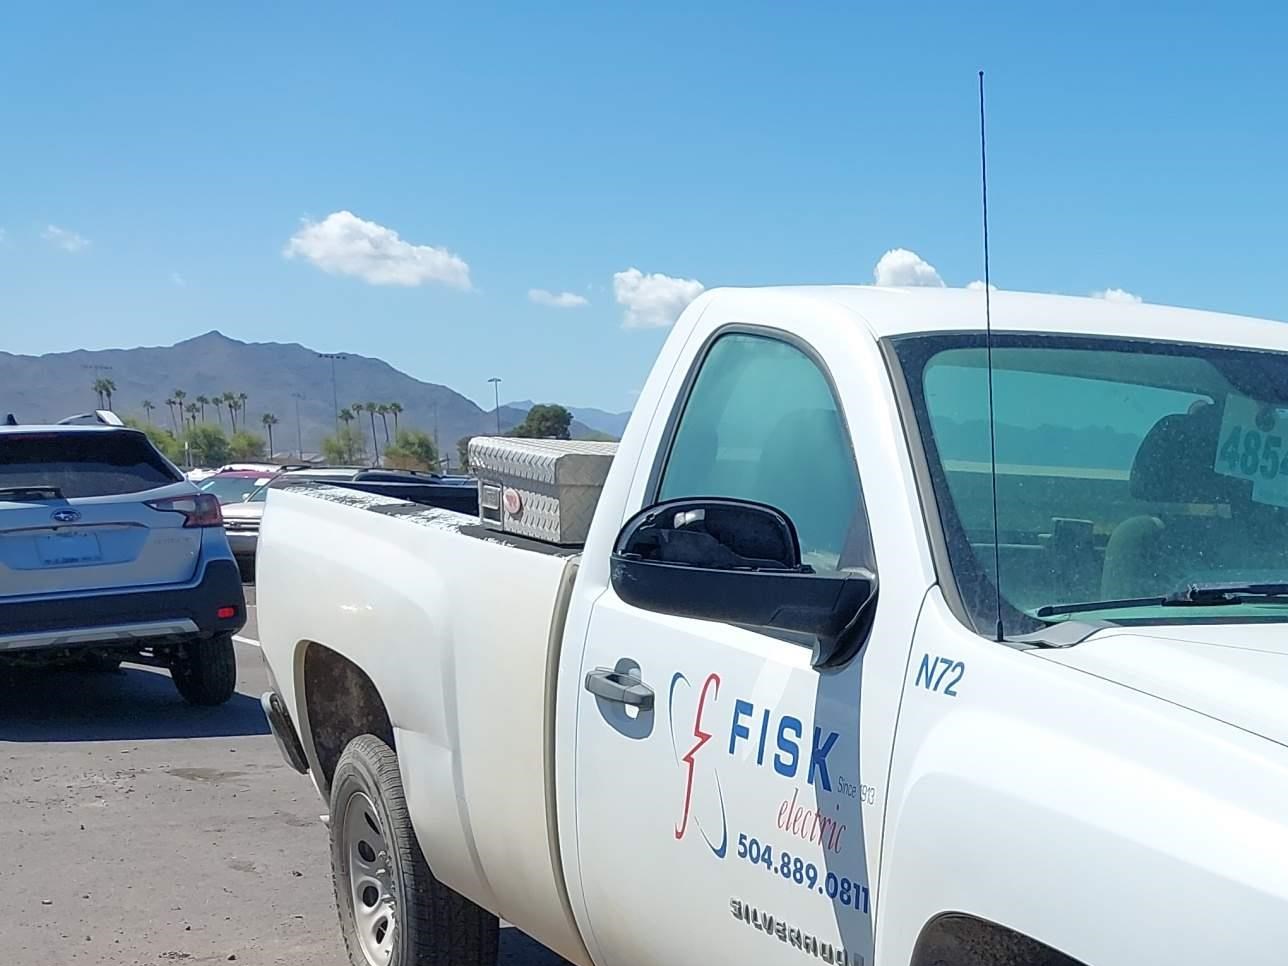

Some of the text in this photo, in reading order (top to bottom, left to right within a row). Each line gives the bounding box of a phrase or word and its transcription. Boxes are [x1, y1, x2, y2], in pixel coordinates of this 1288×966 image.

[915, 653, 965, 697] N72
[729, 698, 840, 792] FISK
[777, 787, 846, 854] electric
[837, 776, 857, 798] Since
[736, 832, 870, 914] 504.889.0811
